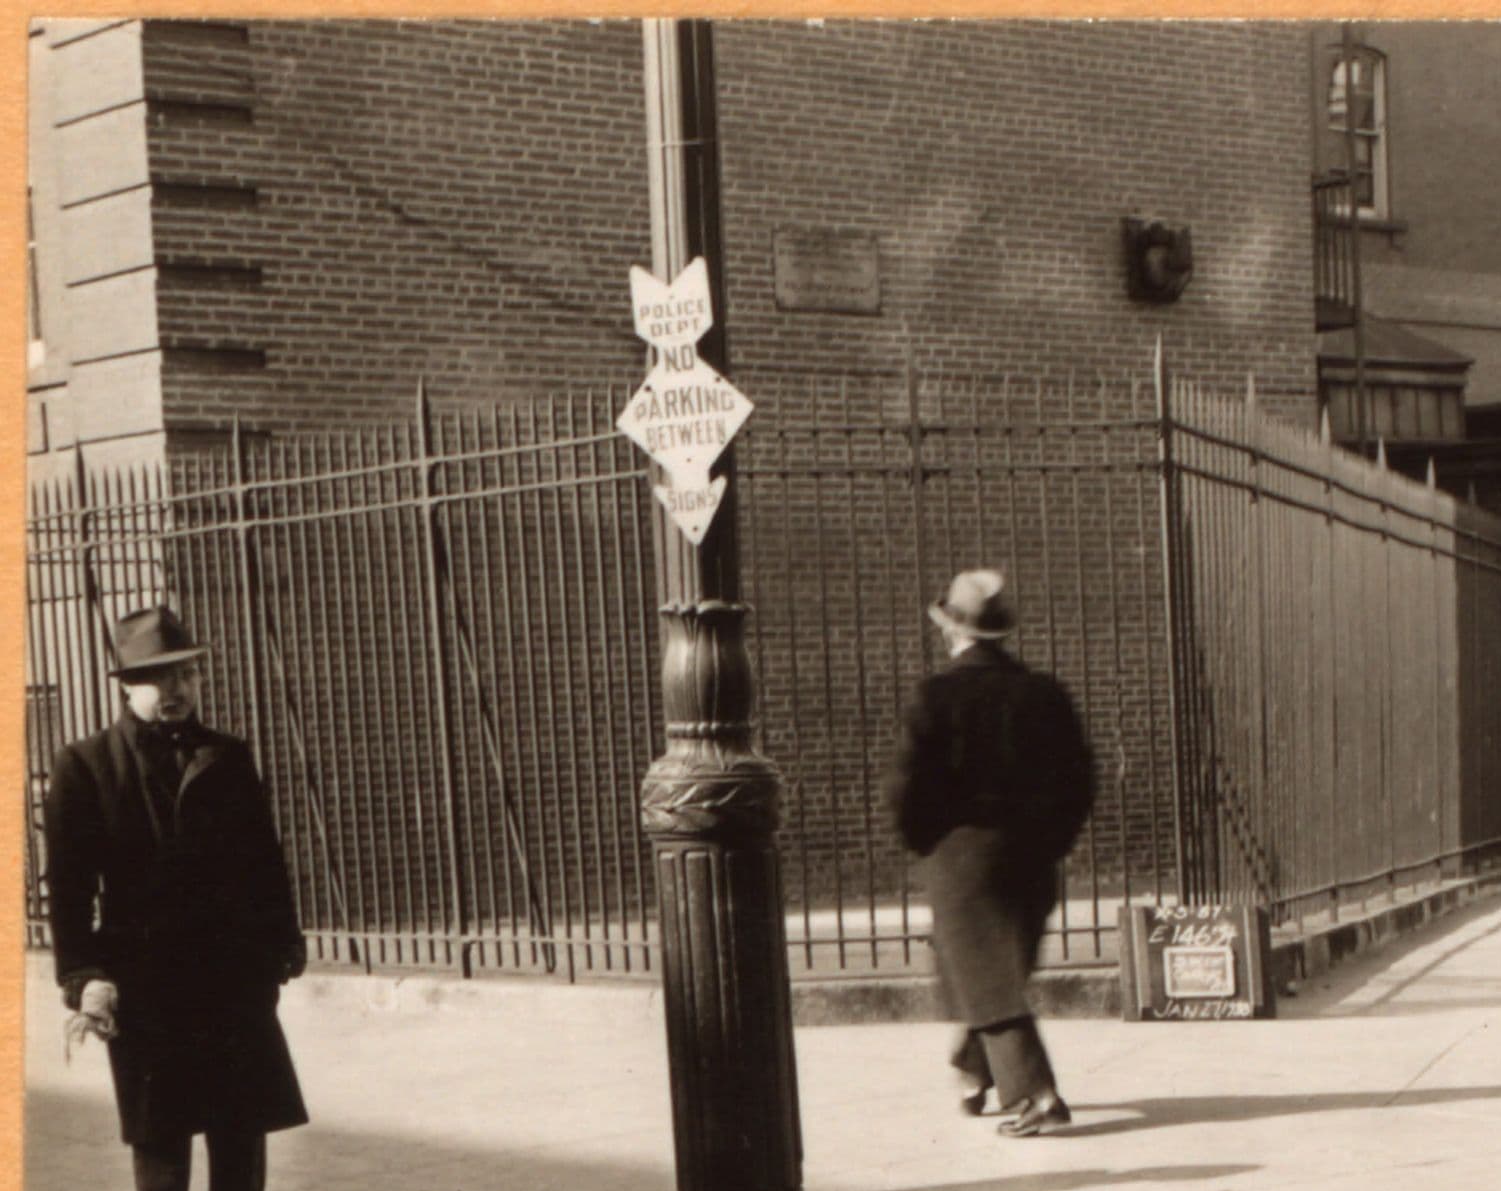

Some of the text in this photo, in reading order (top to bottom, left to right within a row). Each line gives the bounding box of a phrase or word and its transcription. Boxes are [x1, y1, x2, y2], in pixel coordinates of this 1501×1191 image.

[639, 298, 706, 321] POLICE
[649, 319, 701, 338] DEPT
[663, 344, 696, 373] NO
[634, 385, 736, 423] PARKING
[645, 418, 727, 453] BETWEEN
[666, 487, 718, 514] SIGNS
